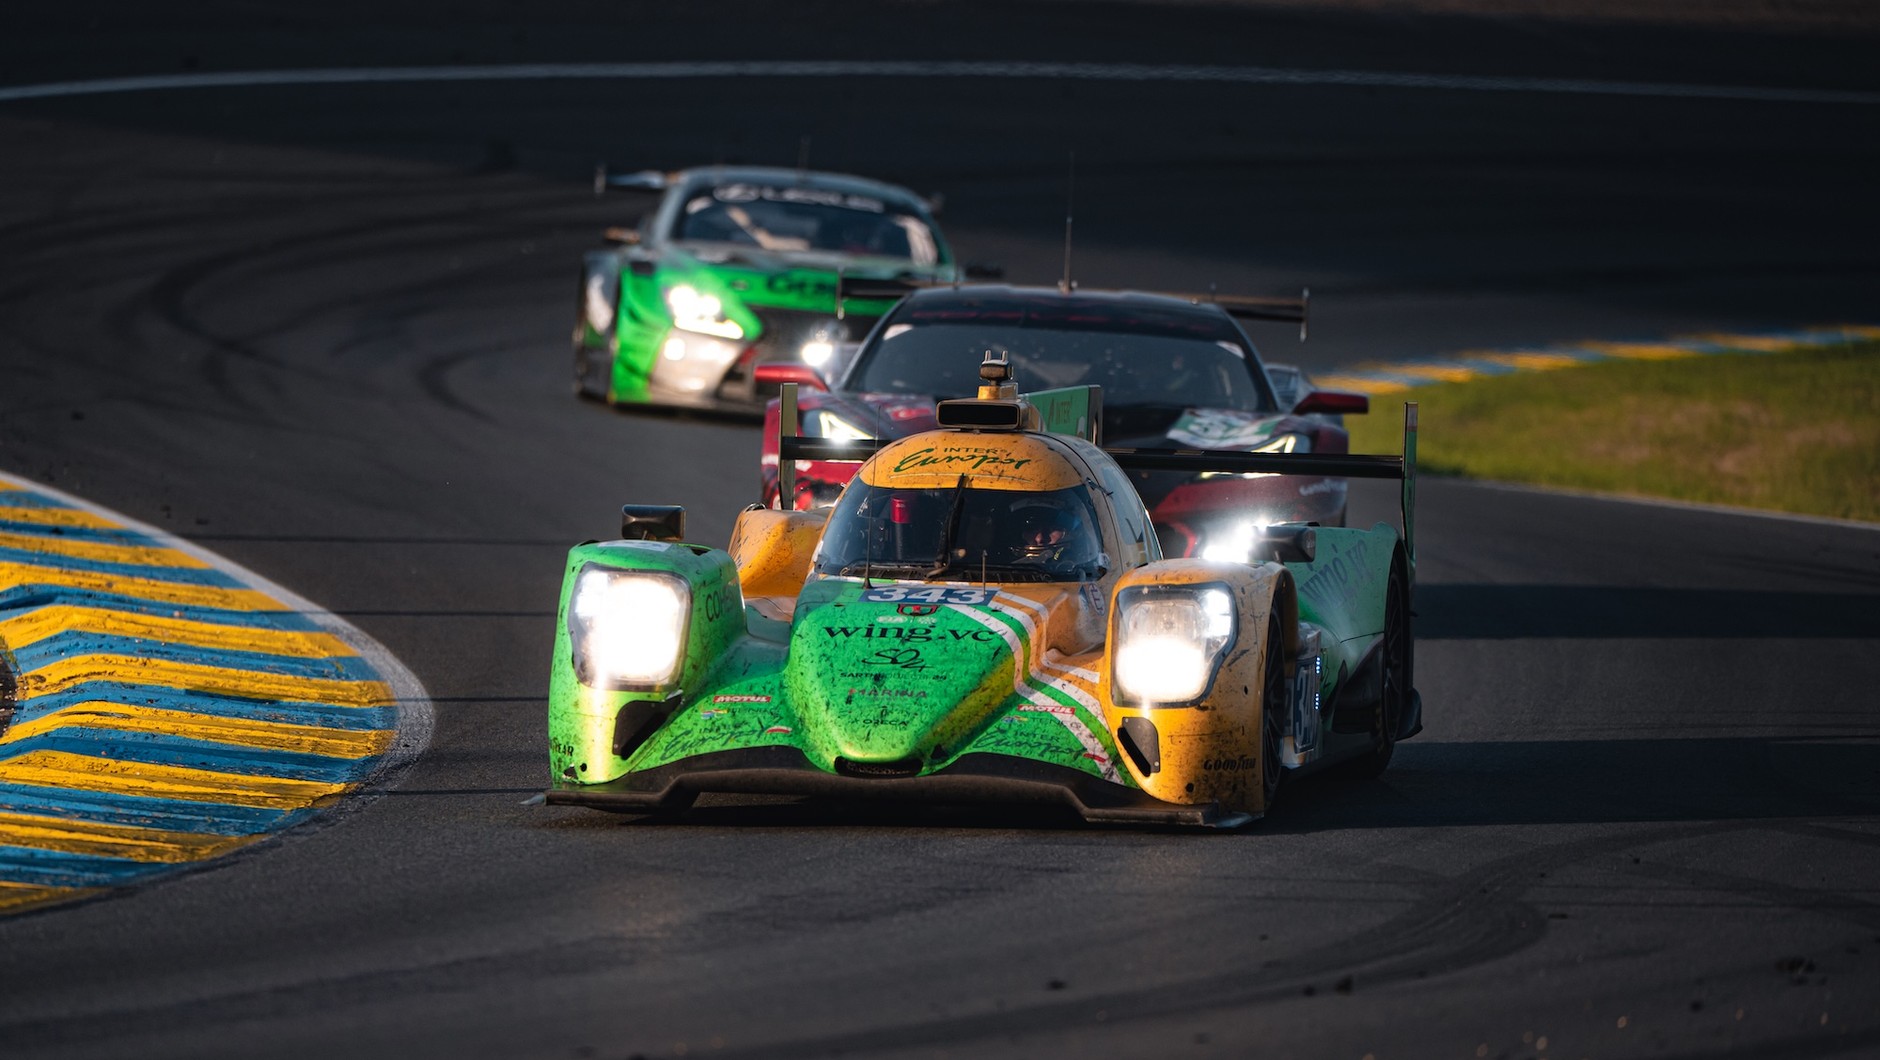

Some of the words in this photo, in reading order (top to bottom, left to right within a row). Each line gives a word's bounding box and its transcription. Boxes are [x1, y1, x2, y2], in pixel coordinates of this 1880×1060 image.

[943, 447, 998, 455] INTER
[868, 587, 984, 604] 343
[824, 624, 994, 642] wing.vc
[1020, 705, 1074, 714] MOTUL
